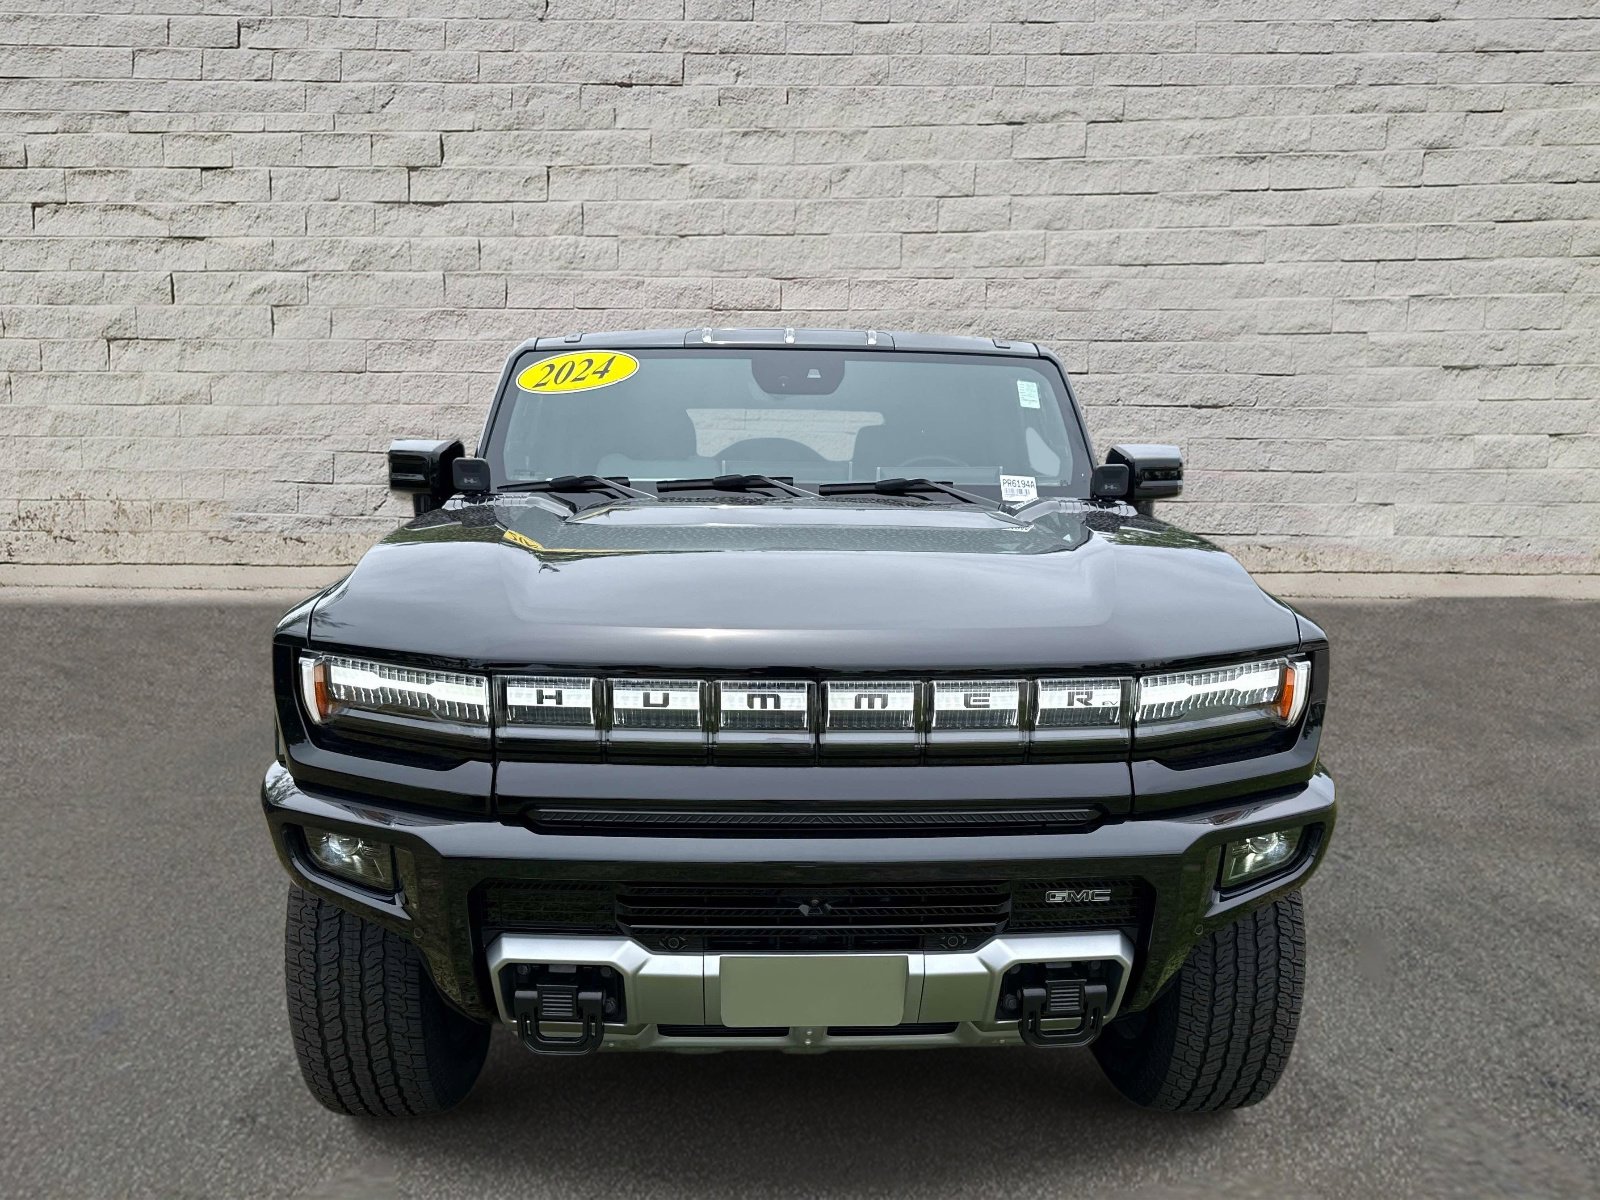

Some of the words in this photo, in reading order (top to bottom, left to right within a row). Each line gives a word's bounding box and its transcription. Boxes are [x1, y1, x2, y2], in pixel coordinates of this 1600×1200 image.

[532, 355, 617, 389] 2024
[536, 688, 1093, 710] HUMMER
[1045, 889, 1112, 903] GMC
